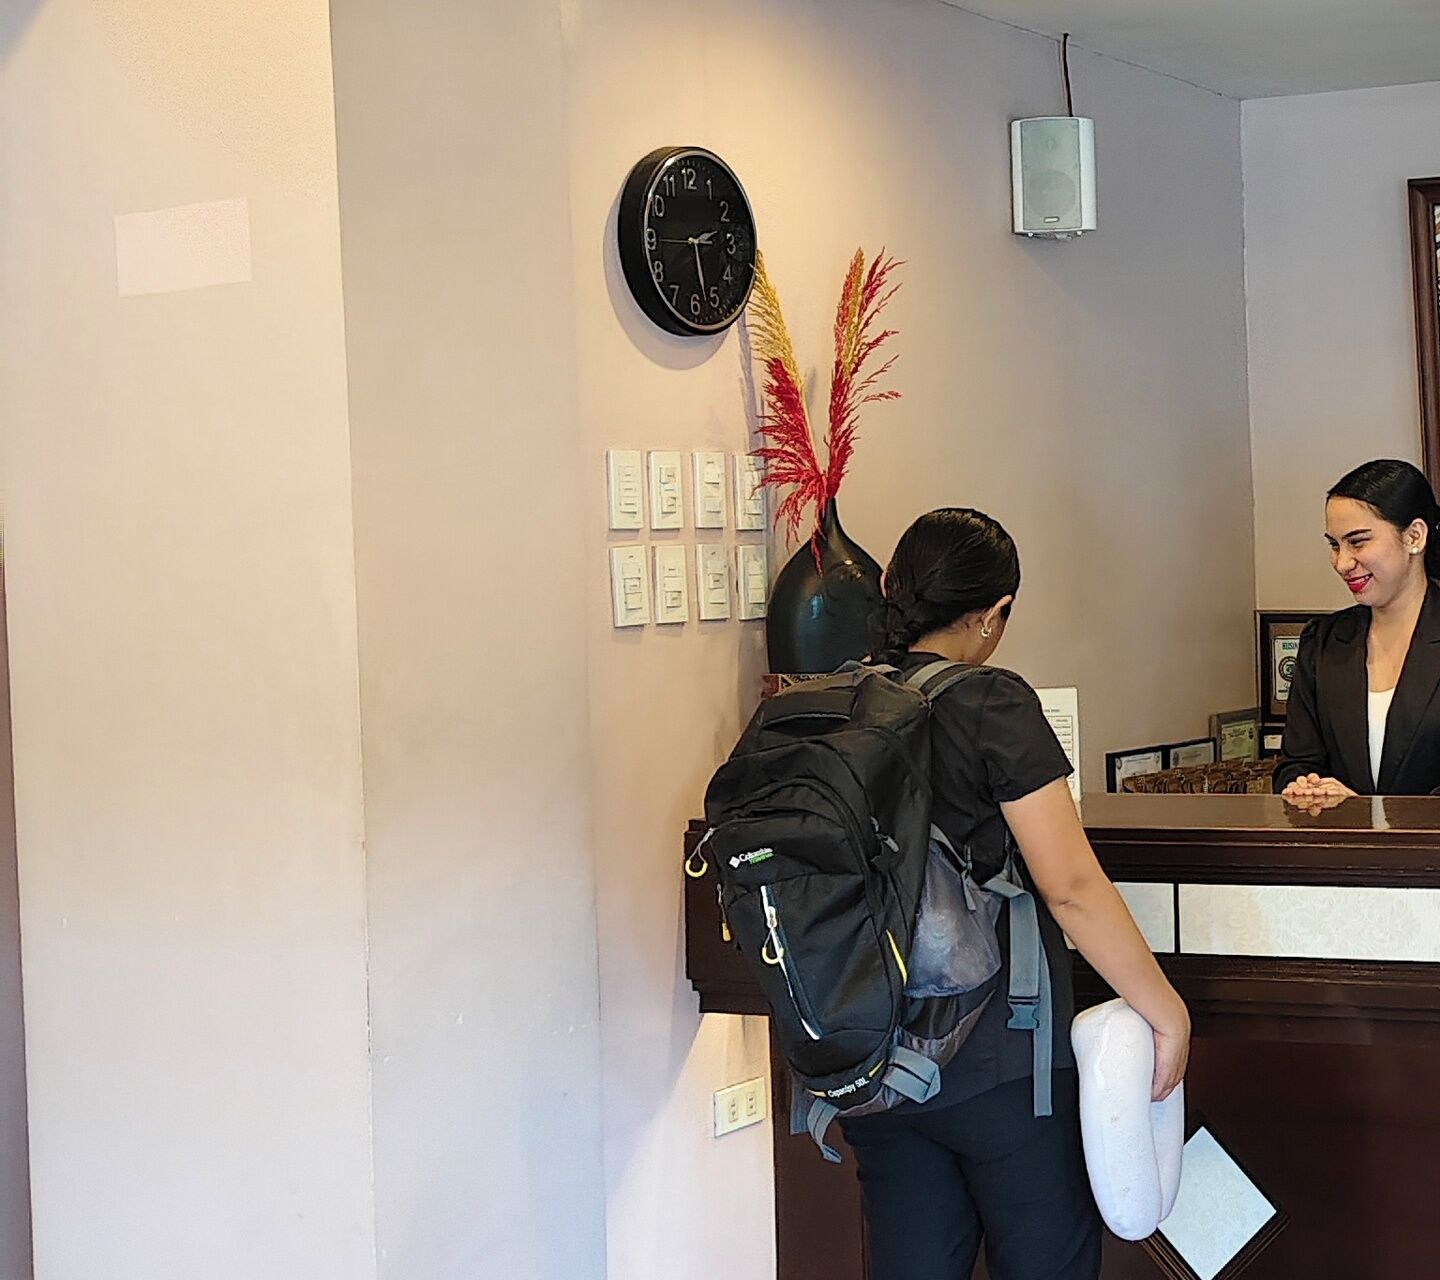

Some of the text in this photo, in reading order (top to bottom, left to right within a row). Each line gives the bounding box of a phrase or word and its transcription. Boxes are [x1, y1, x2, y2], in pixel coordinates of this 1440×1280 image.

[663, 174, 676, 197] 11
[681, 168, 697, 190] 12
[706, 177, 713, 200] 1
[651, 194, 665, 217] 10
[719, 201, 730, 222] 2
[646, 228, 657, 250] 9
[726, 232, 737, 255] 3
[653, 260, 664, 282] 8
[722, 264, 733, 286] 4
[669, 284, 680, 306] 7
[690, 293, 701, 315] 6
[709, 286, 720, 308] 5
